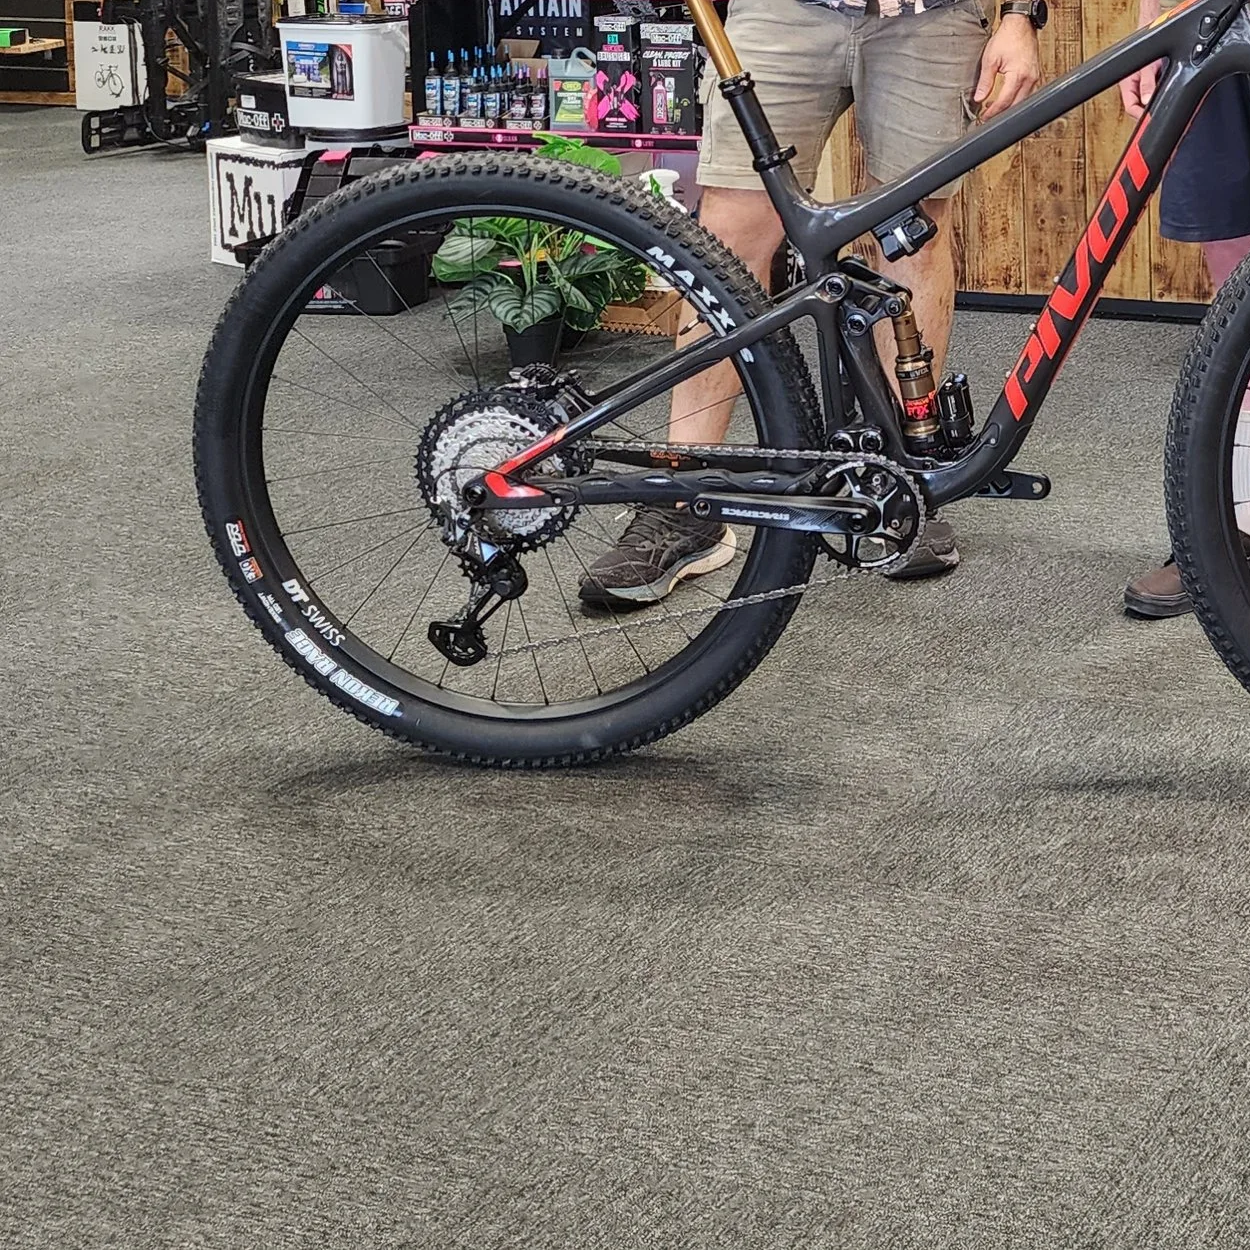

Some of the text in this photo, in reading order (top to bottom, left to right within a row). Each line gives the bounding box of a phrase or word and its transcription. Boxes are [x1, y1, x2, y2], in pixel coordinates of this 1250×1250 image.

[516, 26, 583, 37] SYSTEM
[239, 111, 269, 128] Muc-Off
[1005, 113, 1151, 422] PIVOT
[646, 246, 755, 363] MAXXS
[721, 506, 791, 522] RACEFACE
[282, 578, 346, 647] DT SWISS
[284, 627, 400, 716] REKON RACE
